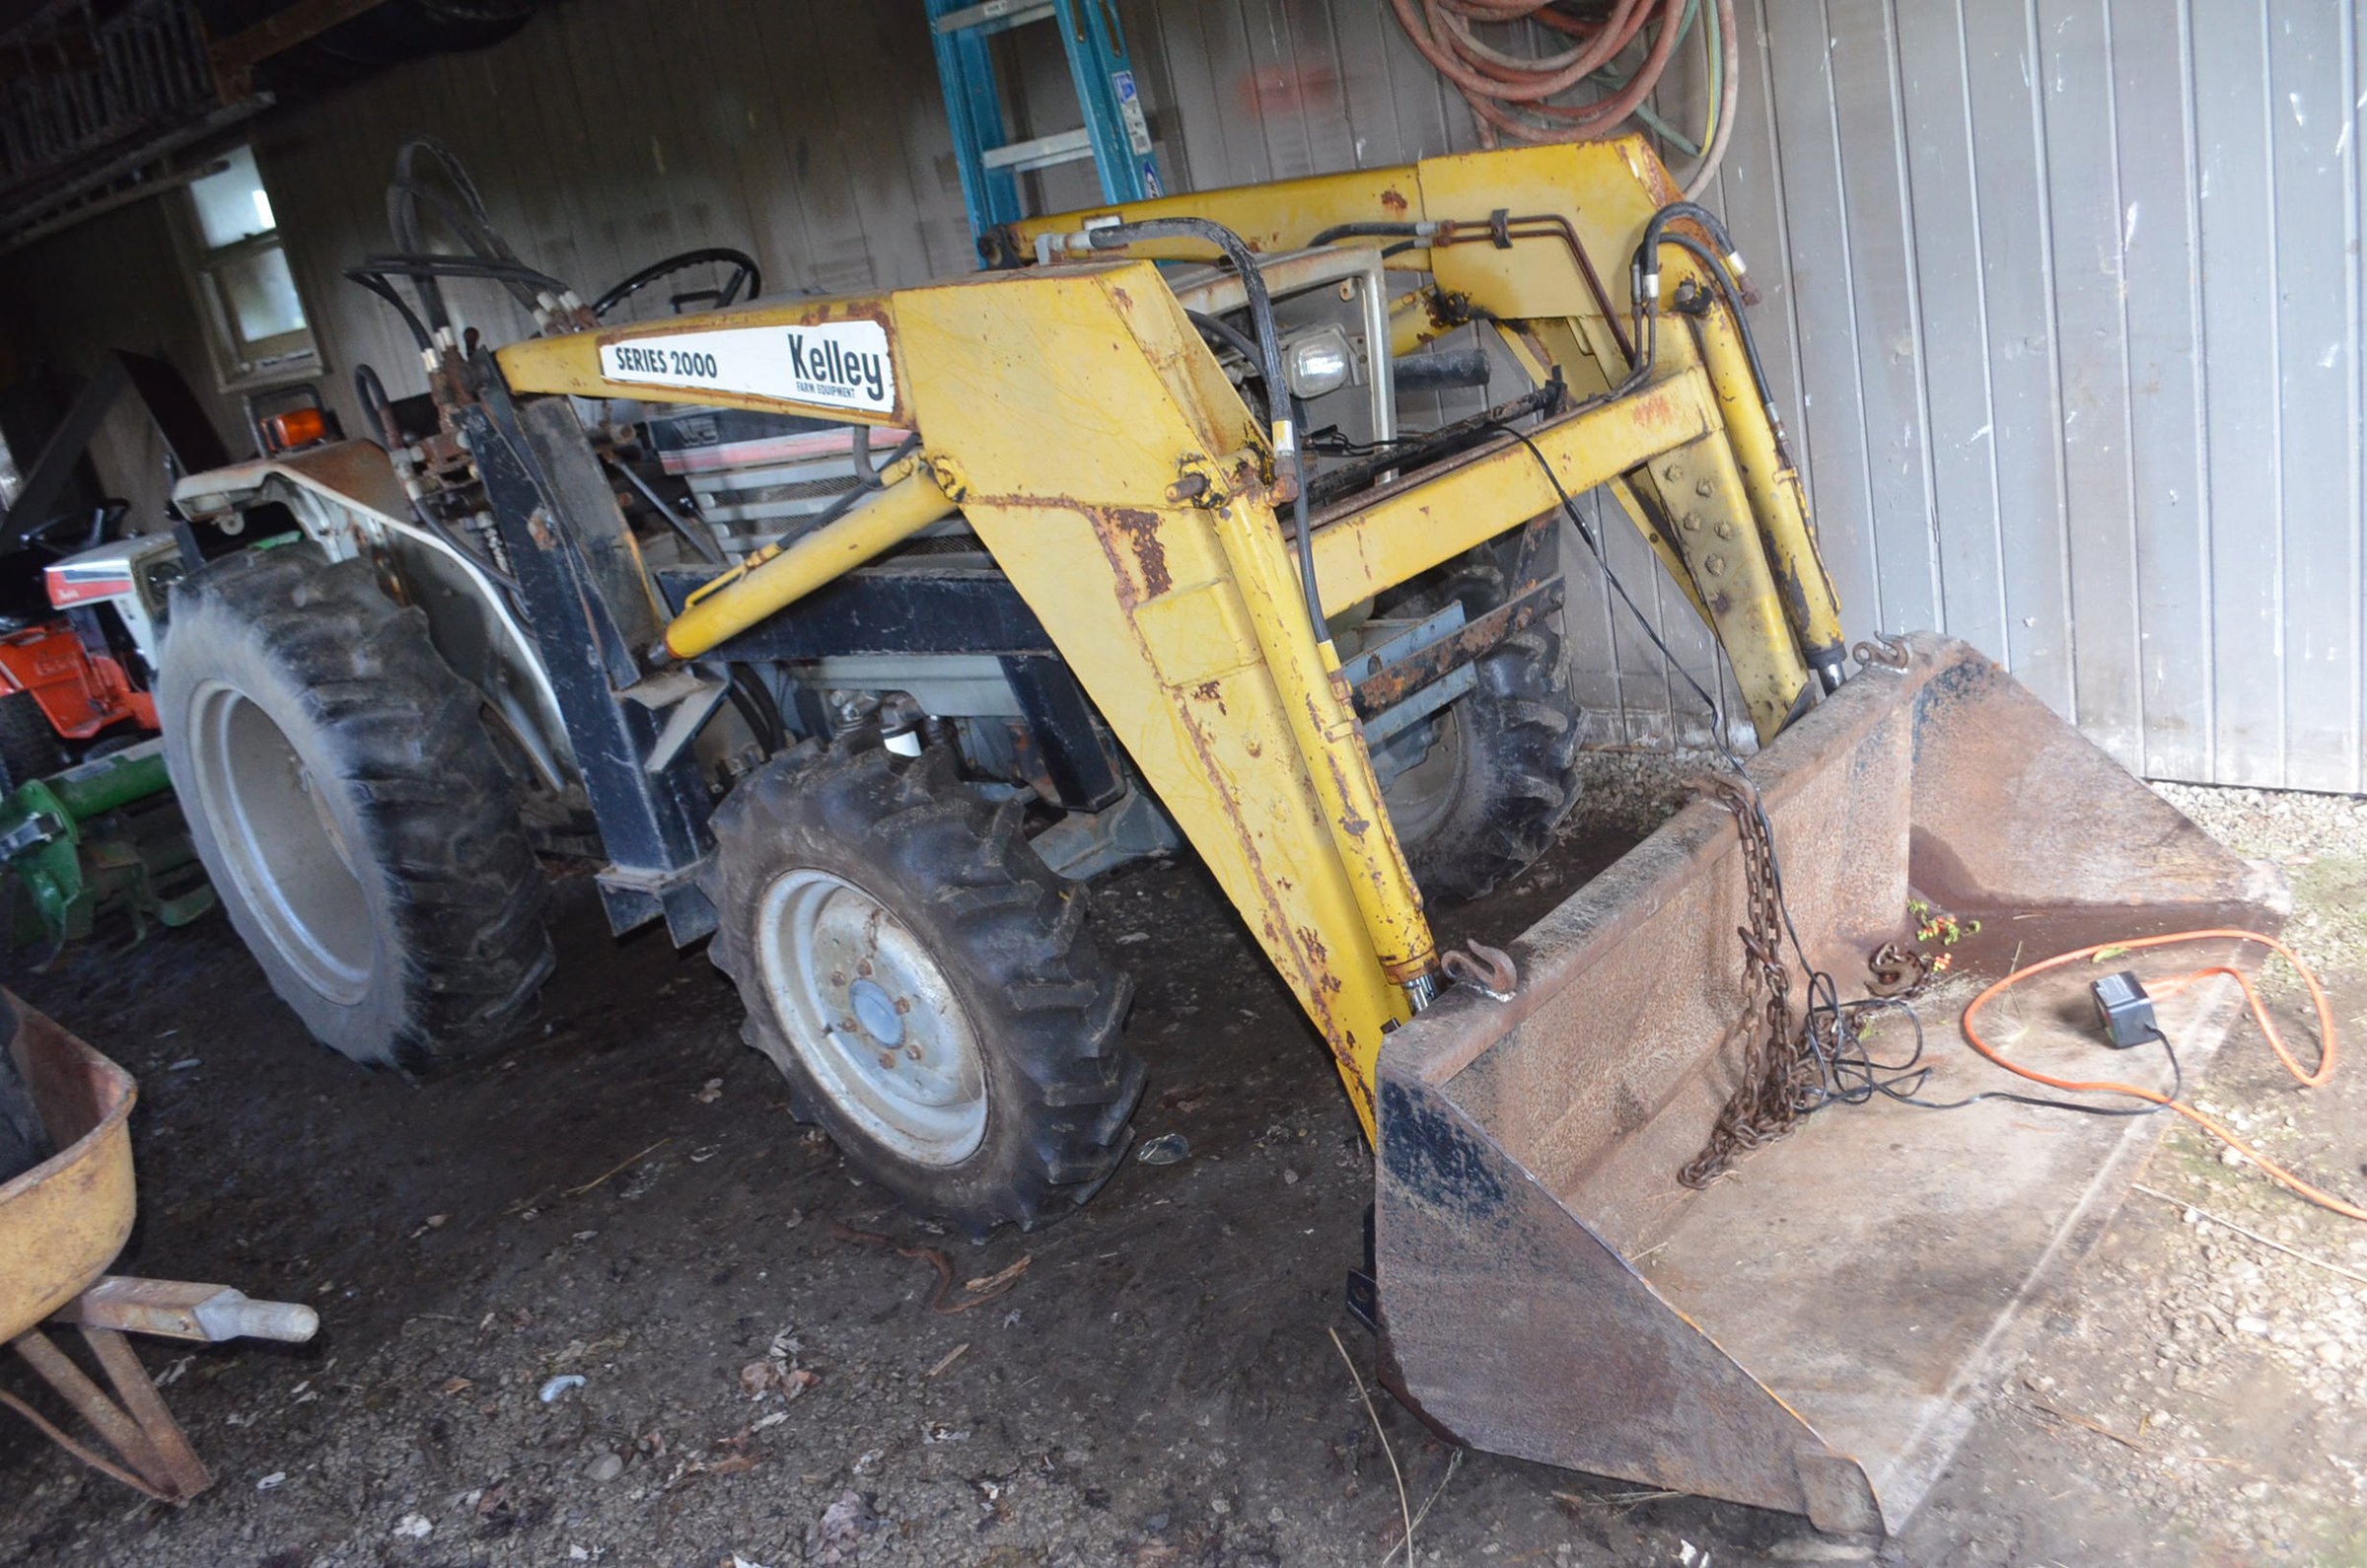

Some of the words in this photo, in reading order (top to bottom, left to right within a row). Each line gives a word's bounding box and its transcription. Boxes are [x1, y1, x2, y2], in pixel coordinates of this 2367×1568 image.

[615, 346, 668, 374] SERIES
[671, 350, 718, 379] 2000
[787, 333, 885, 401] Kelley
[796, 381, 815, 393] FARM
[817, 384, 855, 398] EQUIPMENT
